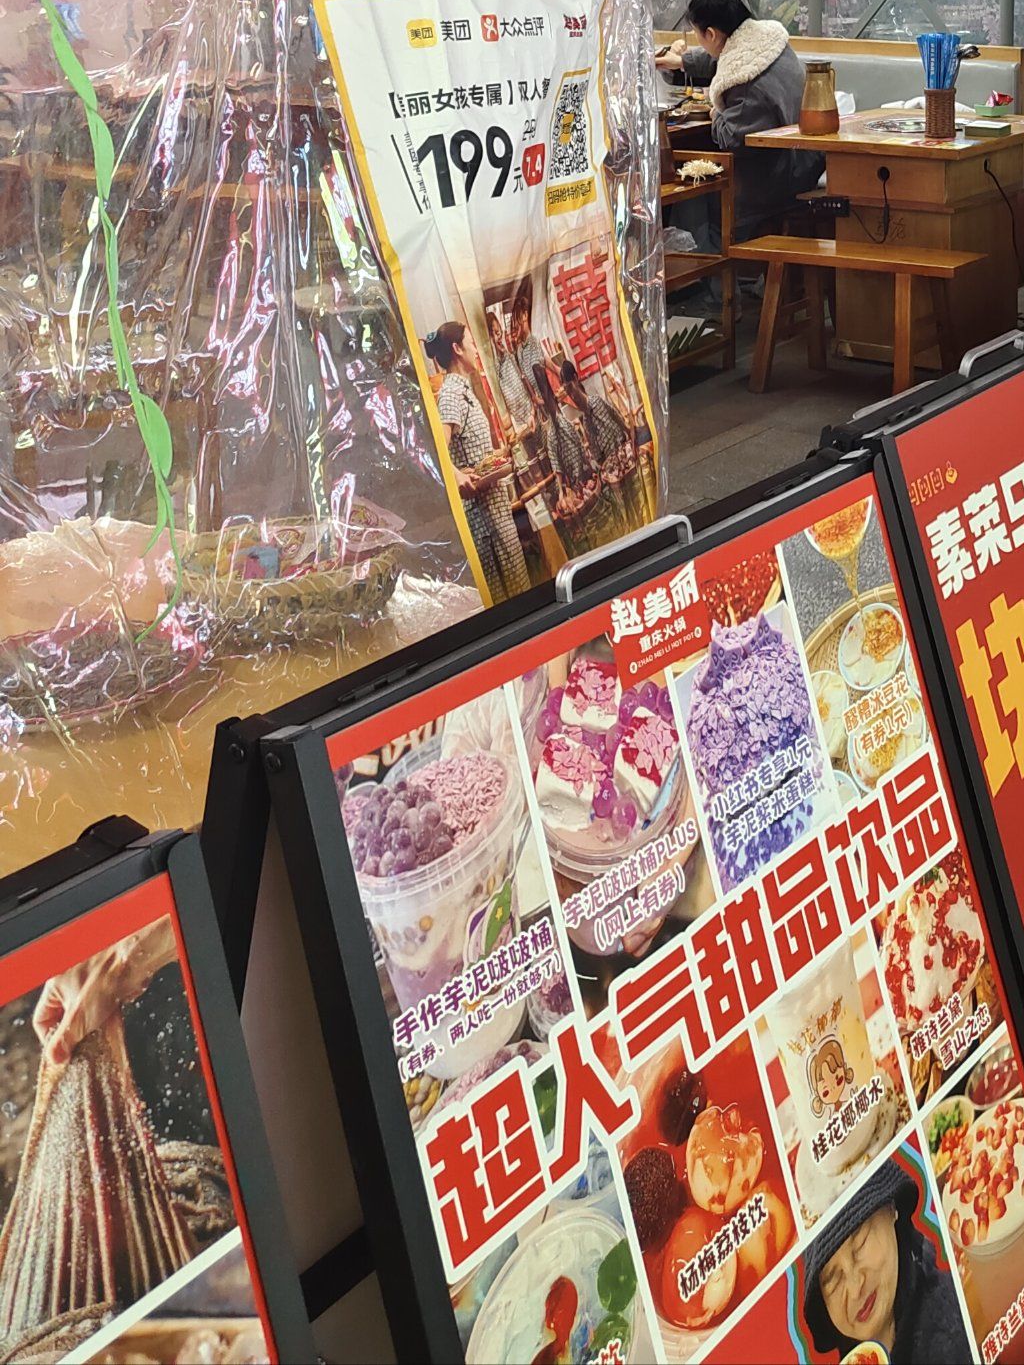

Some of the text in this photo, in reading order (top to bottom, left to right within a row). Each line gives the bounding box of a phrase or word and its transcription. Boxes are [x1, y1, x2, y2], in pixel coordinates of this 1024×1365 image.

[410, 27, 434, 41] 美团
[440, 20, 472, 41] 美团
[500, 16, 545, 37] 大众点评
[416, 125, 514, 209] 199
[610, 560, 699, 643] 赵美丽
[639, 616, 687, 653] 重庆火锅
[637, 654, 653, 668] ZHAO
[714, 737, 812, 820] 小红书专享1元
[724, 769, 816, 849] 芋泥紫米蛋糕
[395, 919, 552, 1045] 手作芋泥啵啵桶
[425, 756, 952, 1271] 超人气甜品饮品
[911, 995, 962, 1058] 雅诗兰黛
[940, 1005, 991, 1067] 雪山之恋
[812, 1078, 883, 1162] 桂花椰椰水
[680, 1195, 767, 1300] 杨梅荔枝饮
